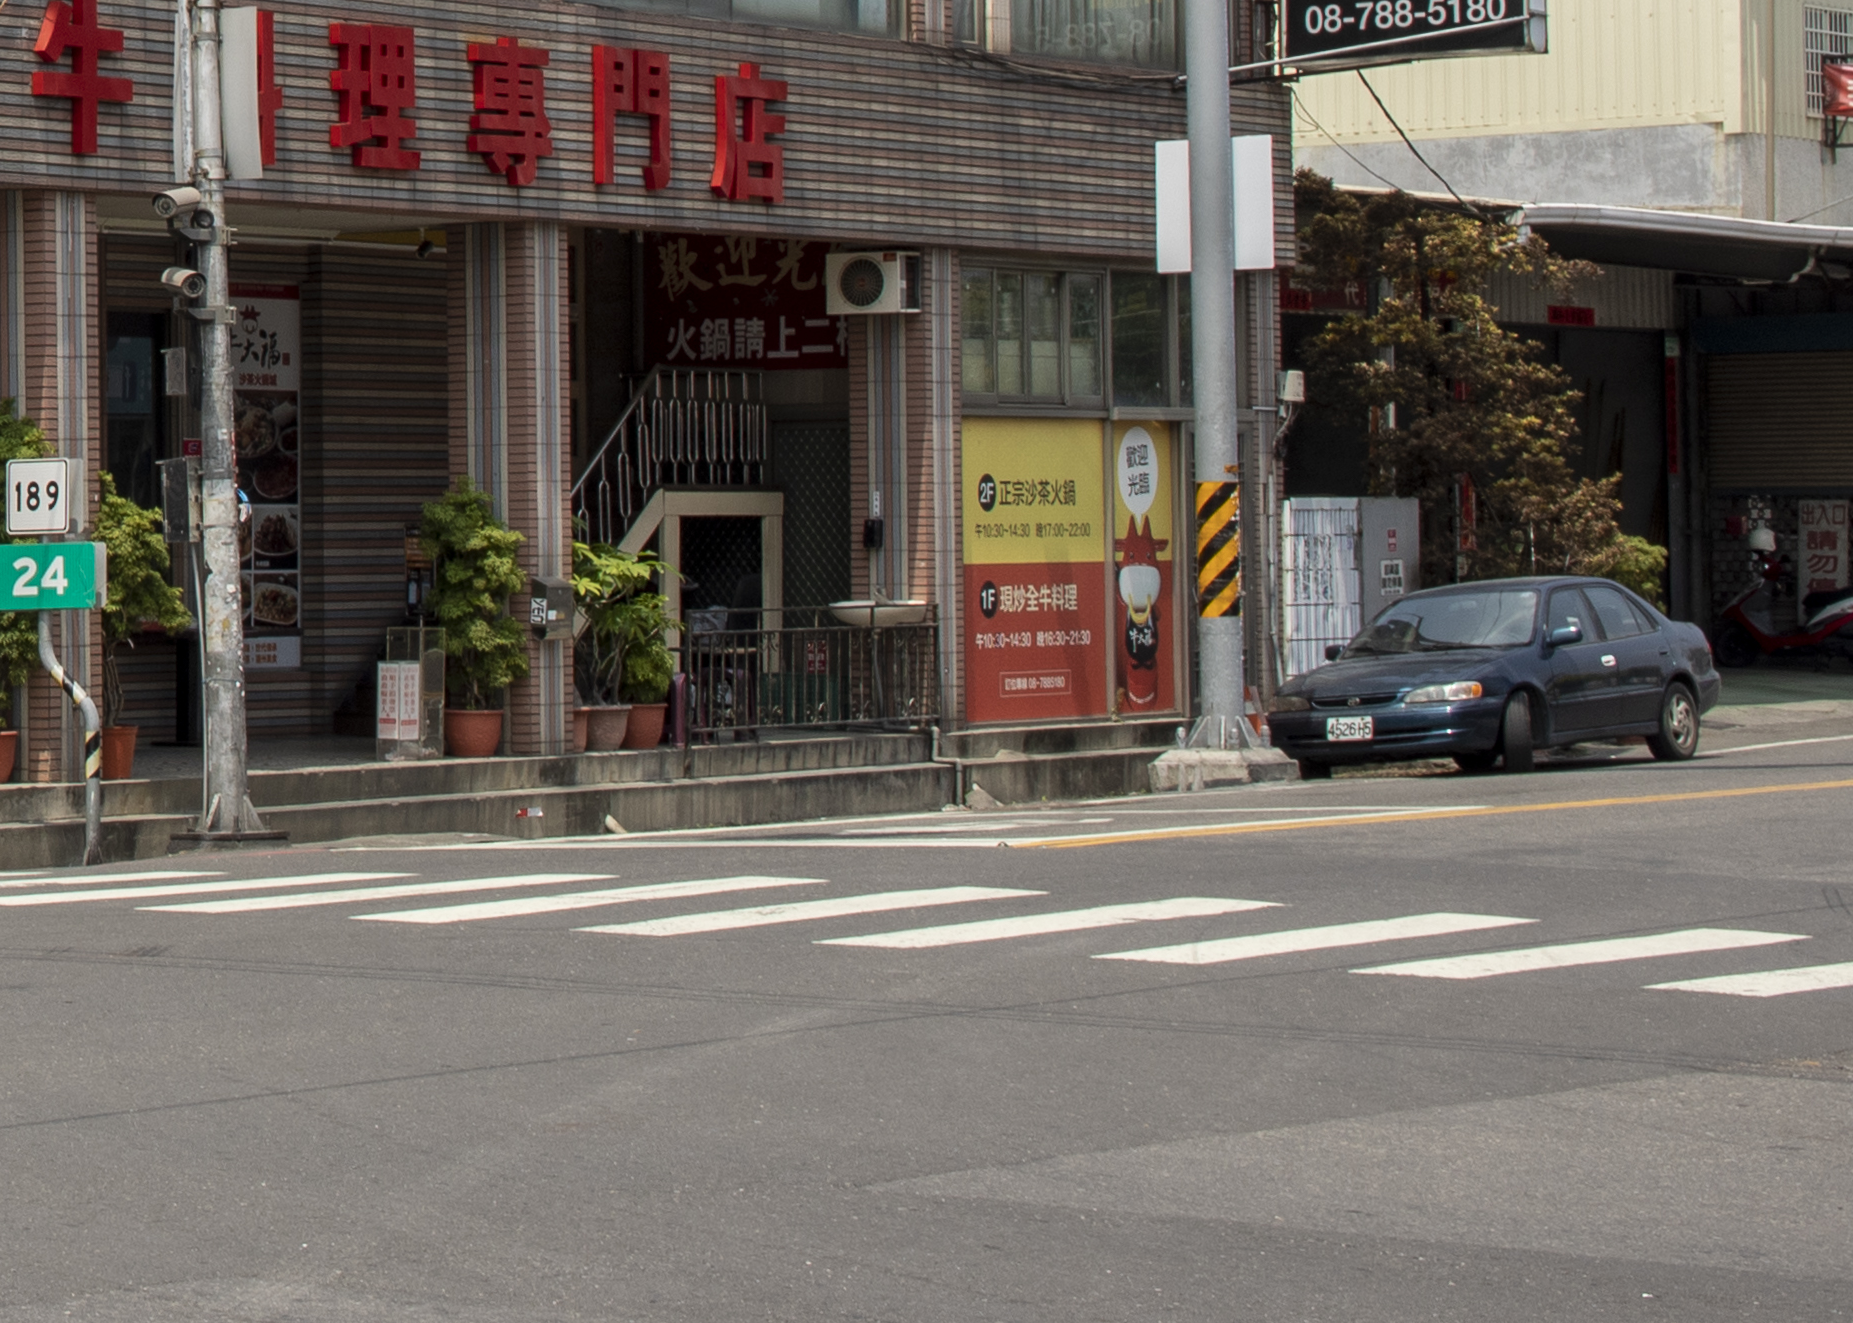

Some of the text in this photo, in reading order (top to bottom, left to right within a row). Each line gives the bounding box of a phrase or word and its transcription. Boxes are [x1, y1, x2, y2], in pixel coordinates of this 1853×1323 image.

[657, 235, 842, 302] 歡迎光
[1125, 443, 1149, 469] 歡迎
[14, 480, 59, 513] 189
[979, 478, 1076, 506] 2F 正宗沙茶火鍋
[1127, 471, 1150, 498] 光臨
[1801, 503, 1846, 526] 出入口
[11, 555, 69, 597] 24
[980, 583, 1079, 613] 1F 現炒全牛料理
